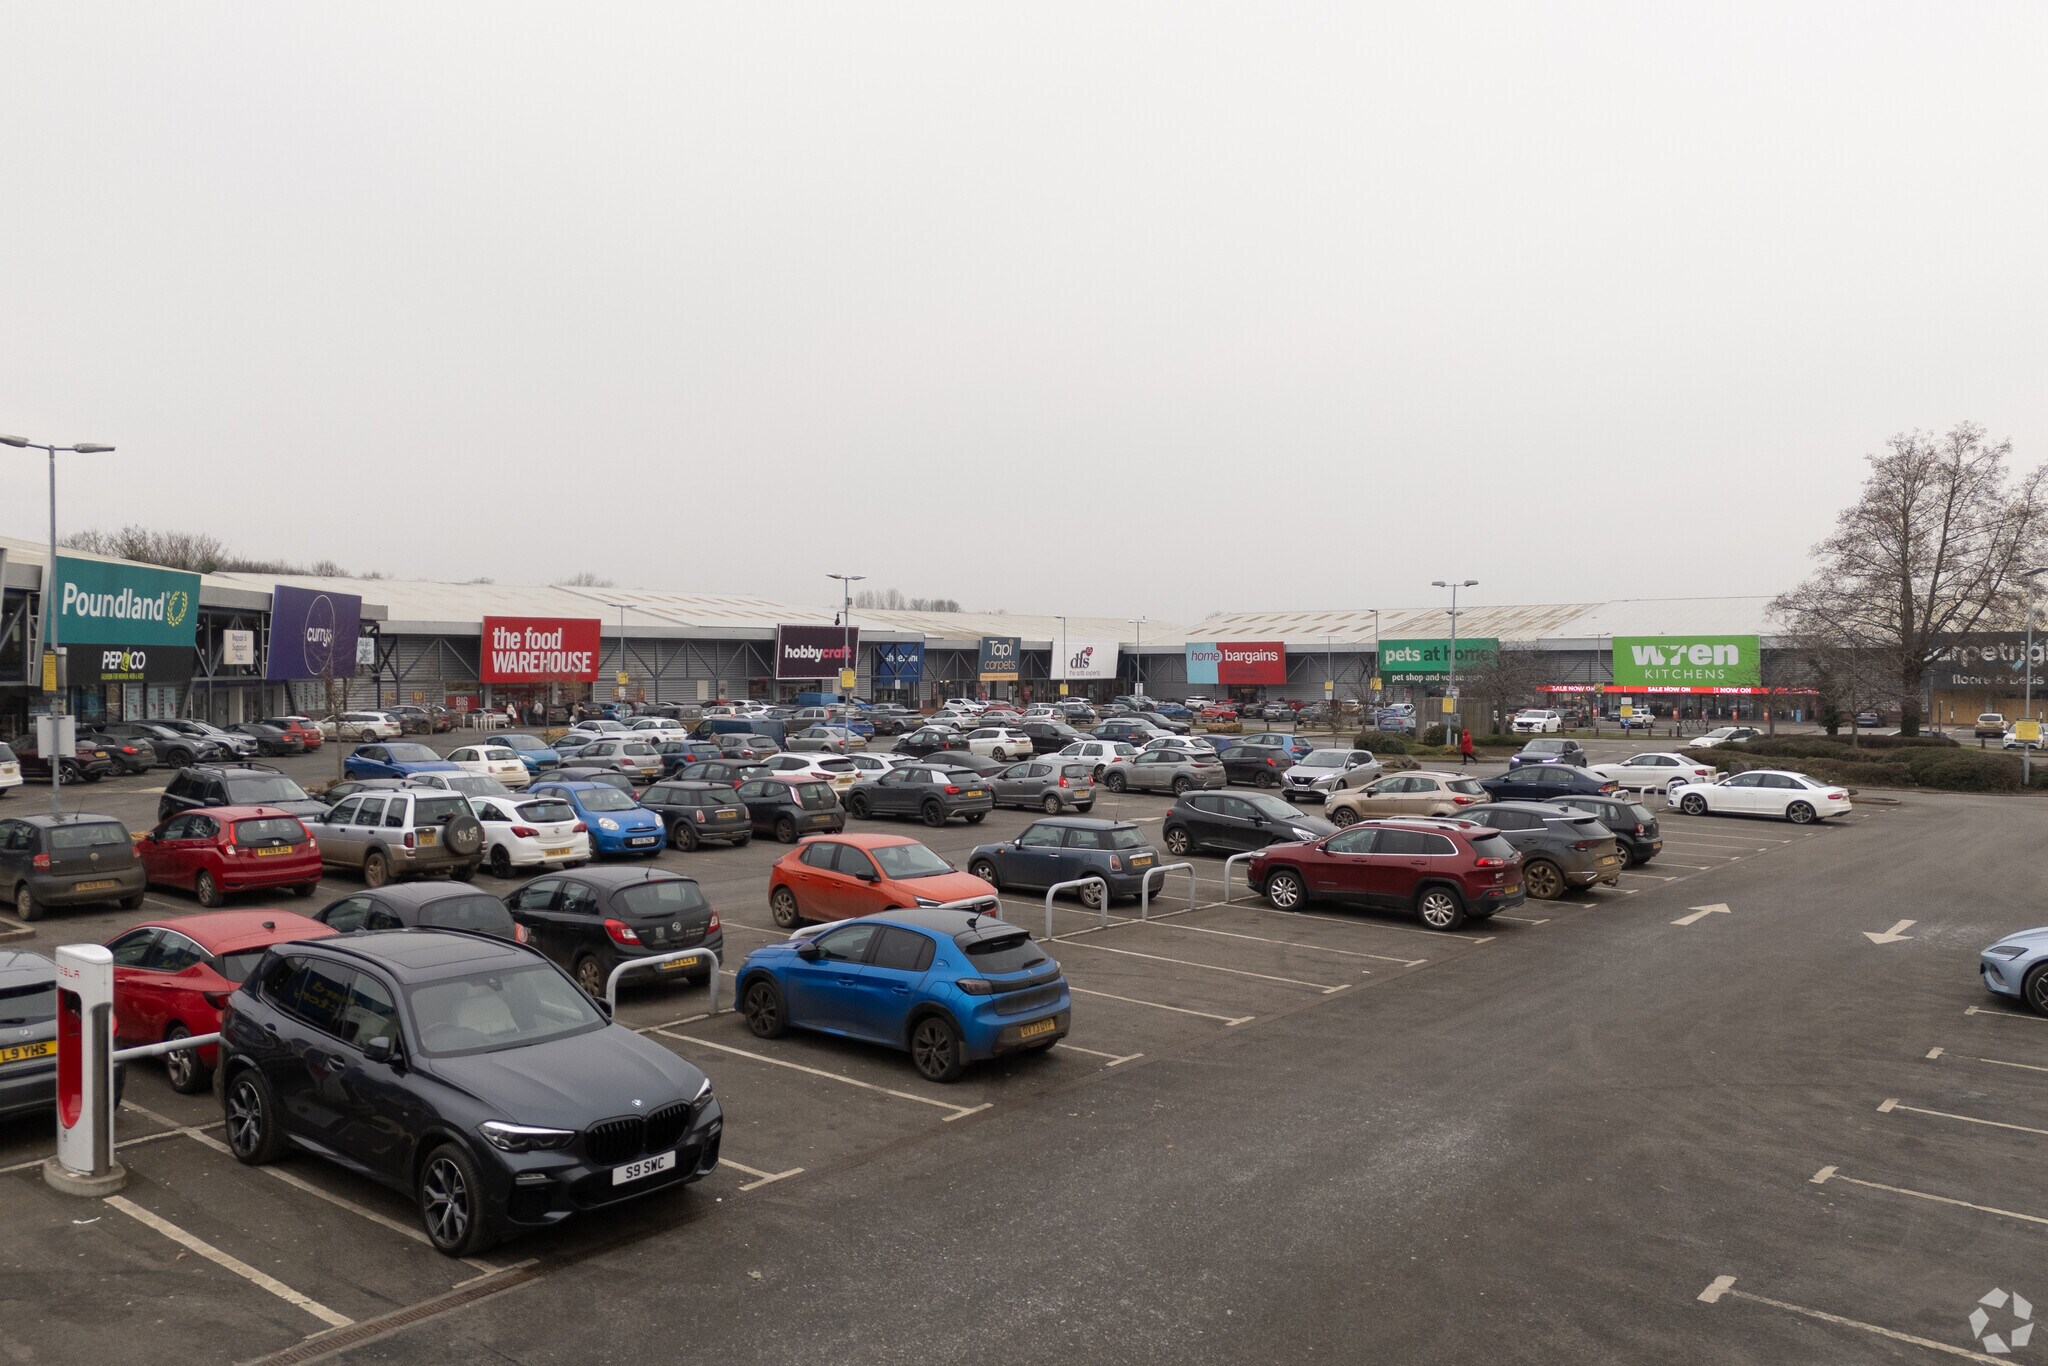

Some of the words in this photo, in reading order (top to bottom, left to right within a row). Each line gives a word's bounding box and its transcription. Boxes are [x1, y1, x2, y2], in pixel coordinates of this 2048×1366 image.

[62, 582, 165, 621] Poundland
[492, 626, 520, 650] the
[524, 626, 562, 650] food
[785, 645, 852, 662] hobbycraft
[989, 640, 1012, 659] Tapi
[1191, 650, 1220, 661] home
[1224, 649, 1278, 664] bargains
[1385, 647, 1420, 664] pets
[1424, 646, 1440, 661] at
[1632, 644, 1739, 666] wren
[492, 651, 592, 673] WAREHOUSE
[984, 660, 1016, 671] carpets
[1070, 650, 1090, 668] dfs
[1392, 673, 1404, 683] pet
[1406, 673, 1424, 683] shop
[1426, 673, 1440, 681] and
[1645, 670, 1725, 679] KITCHENS
[2, 1048, 19, 1060] L9
[22, 1043, 48, 1057] YHS
[626, 1164, 640, 1178] S9
[644, 1156, 664, 1174] SWC
